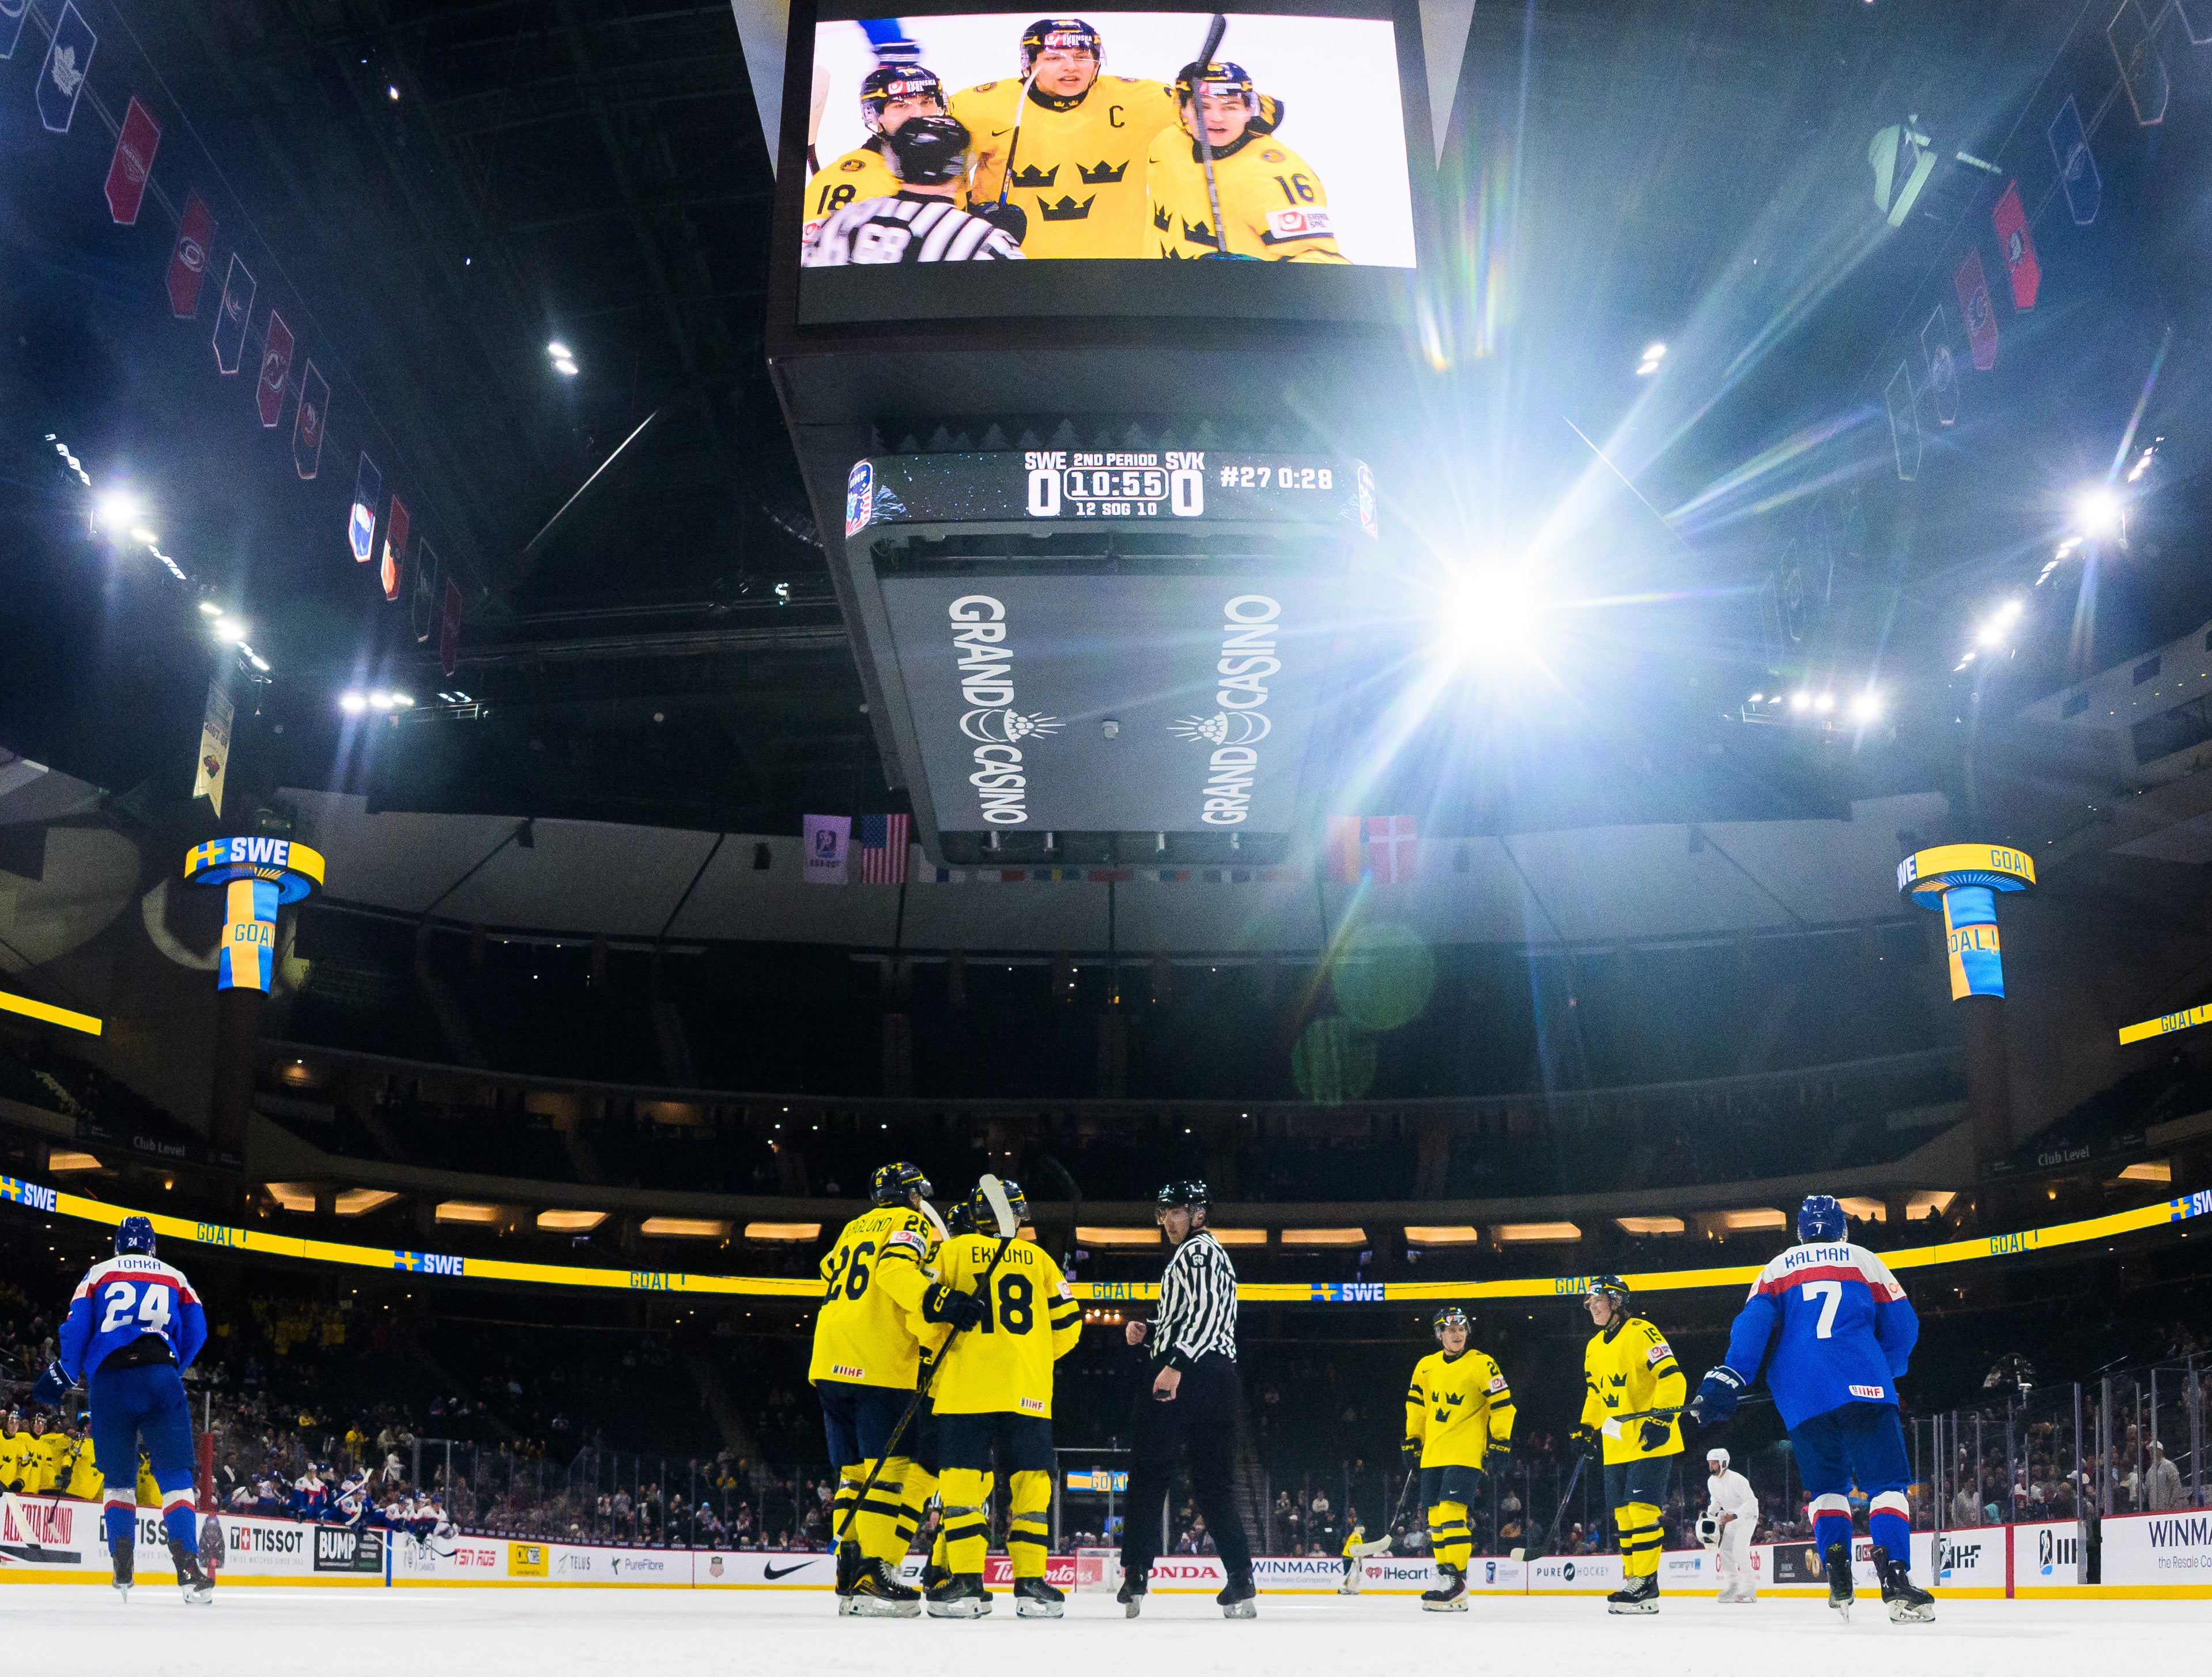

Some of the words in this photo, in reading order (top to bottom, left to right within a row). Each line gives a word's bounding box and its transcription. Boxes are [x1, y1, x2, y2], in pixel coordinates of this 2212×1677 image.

[1109, 105, 1124, 128] C
[817, 184, 856, 214] 18
[1273, 174, 1315, 205] 16
[1025, 451, 1067, 470] SWE
[1073, 453, 1103, 466] 2ND
[1106, 453, 1157, 466] PERIOD
[1165, 451, 1206, 470] SVK
[1071, 471, 1162, 496] 10:55
[1220, 466, 1271, 488] #27
[1278, 467, 1333, 490] 0:28
[1028, 469, 1061, 517] 0
[1171, 469, 1204, 517] 0
[1076, 502, 1096, 516] 12
[1102, 502, 1131, 516] SOG
[1137, 502, 1157, 516] 10
[949, 594, 1014, 707] GRAND
[1216, 594, 1281, 709] CASINO
[969, 744, 1028, 824] CASINO
[1201, 747, 1258, 825] GRAND
[230, 836, 289, 866] SWE
[1897, 854, 1917, 892] WE
[133, 1136, 156, 1151] Club
[158, 1140, 186, 1157] Level
[2038, 1151, 2062, 1167] Club
[2064, 1145, 2090, 1162] Level
[24, 1182, 56, 1212] SWE
[2193, 1189, 2212, 1216] SW
[903, 1215, 930, 1239] 26
[1816, 1223, 1822, 1234] 7
[128, 1237, 138, 1246] 24
[116, 1259, 161, 1270] TOMKA
[424, 1253, 463, 1276] SWE
[1785, 1248, 1849, 1269] KALMAN
[824, 1241, 876, 1306] 26
[1556, 1276, 1593, 1294] GOA
[933, 1286, 950, 1313] CC
[1342, 1283, 1384, 1302] SWE
[101, 1282, 171, 1332] 24
[1802, 1280, 1843, 1339] 7
[1643, 1327, 1662, 1344] 15
[840, 1366, 863, 1377] IIHF
[1858, 1386, 1881, 1397] IIHF
[1026, 1399, 1043, 1410] IIHF
[253, 1528, 304, 1552] TISSOT
[319, 1531, 357, 1559] BUMP
[571, 1556, 591, 1570] TELUS
[625, 1558, 664, 1570] PureFibre
[1252, 1561, 1343, 1573] WINMARK
[1537, 1567, 1562, 1577] PURE
[1577, 1566, 1609, 1577] HOCKEY
[2158, 1557, 2171, 1569] the
[2173, 1555, 2199, 1569] Resale
